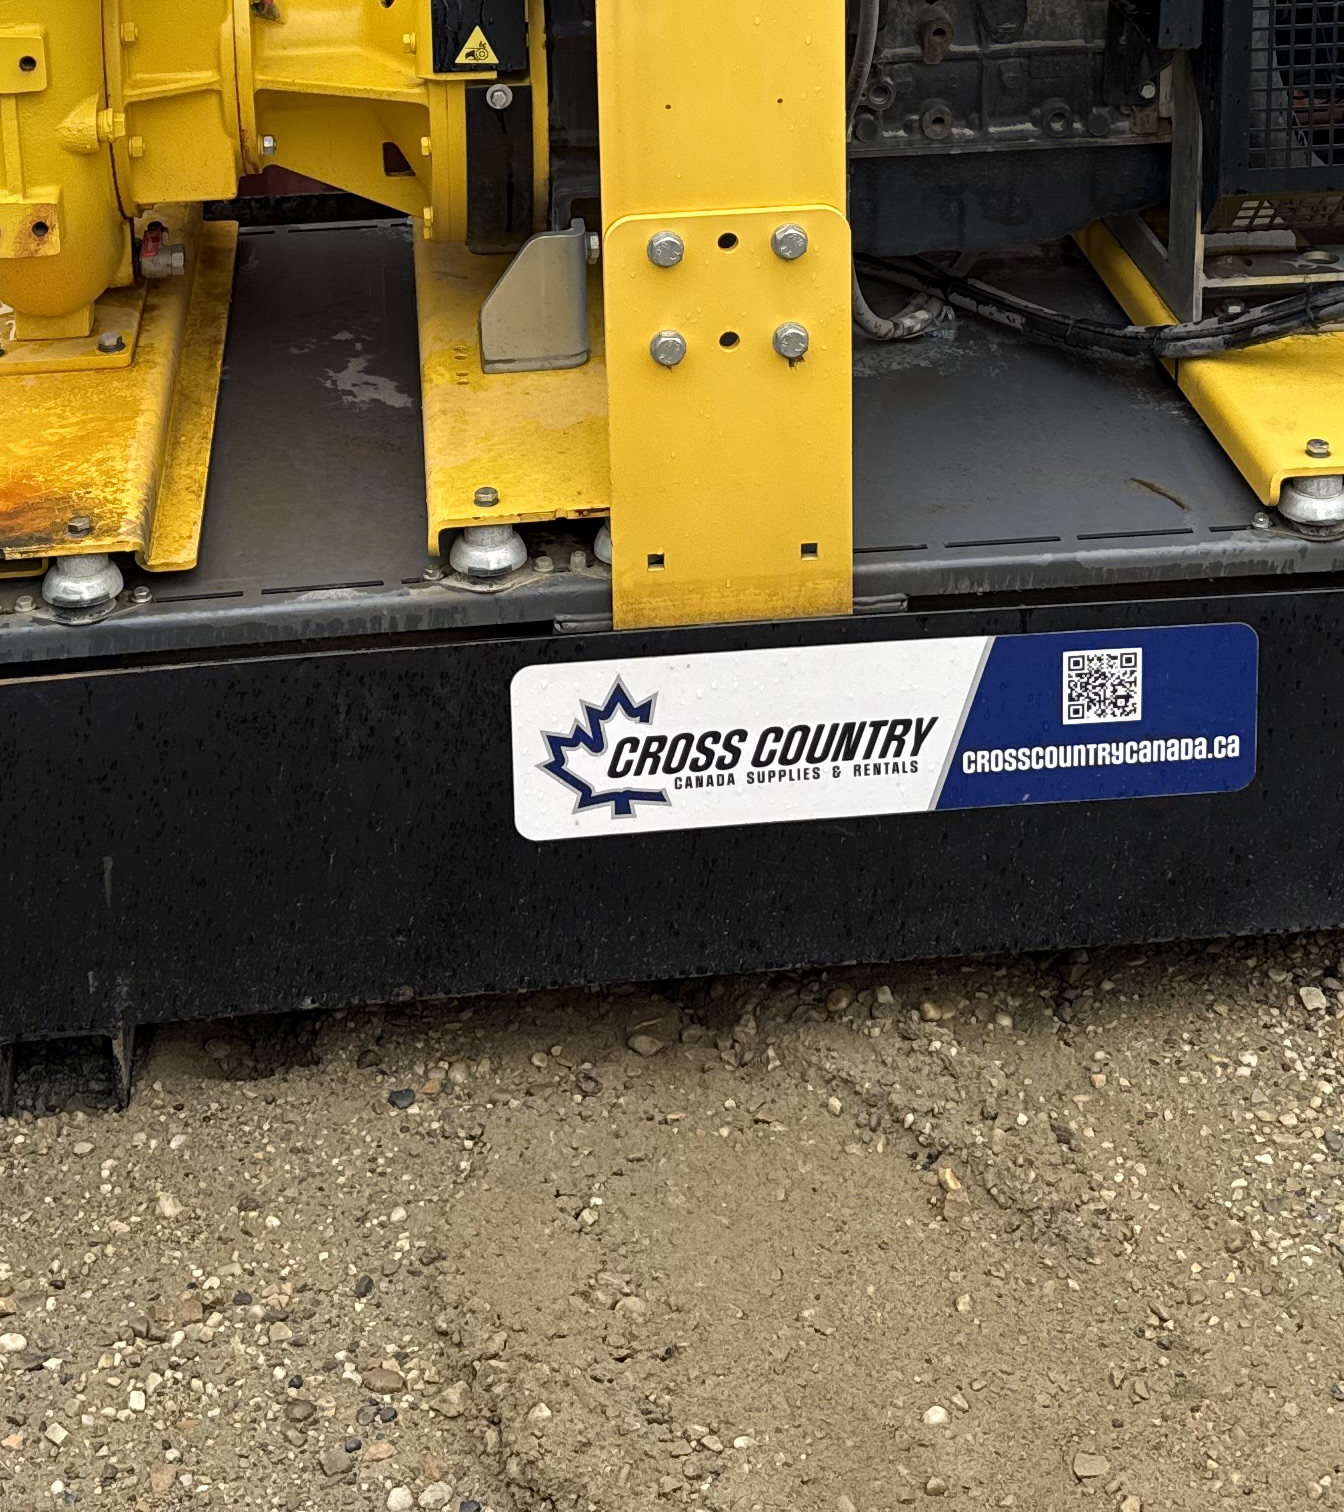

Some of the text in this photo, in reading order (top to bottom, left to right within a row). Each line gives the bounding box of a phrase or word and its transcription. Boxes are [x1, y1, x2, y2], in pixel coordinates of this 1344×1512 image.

[607, 716, 939, 778] CROSS COUNTRY
[674, 759, 919, 790] CANADA SUPPLIES & RENTALS
